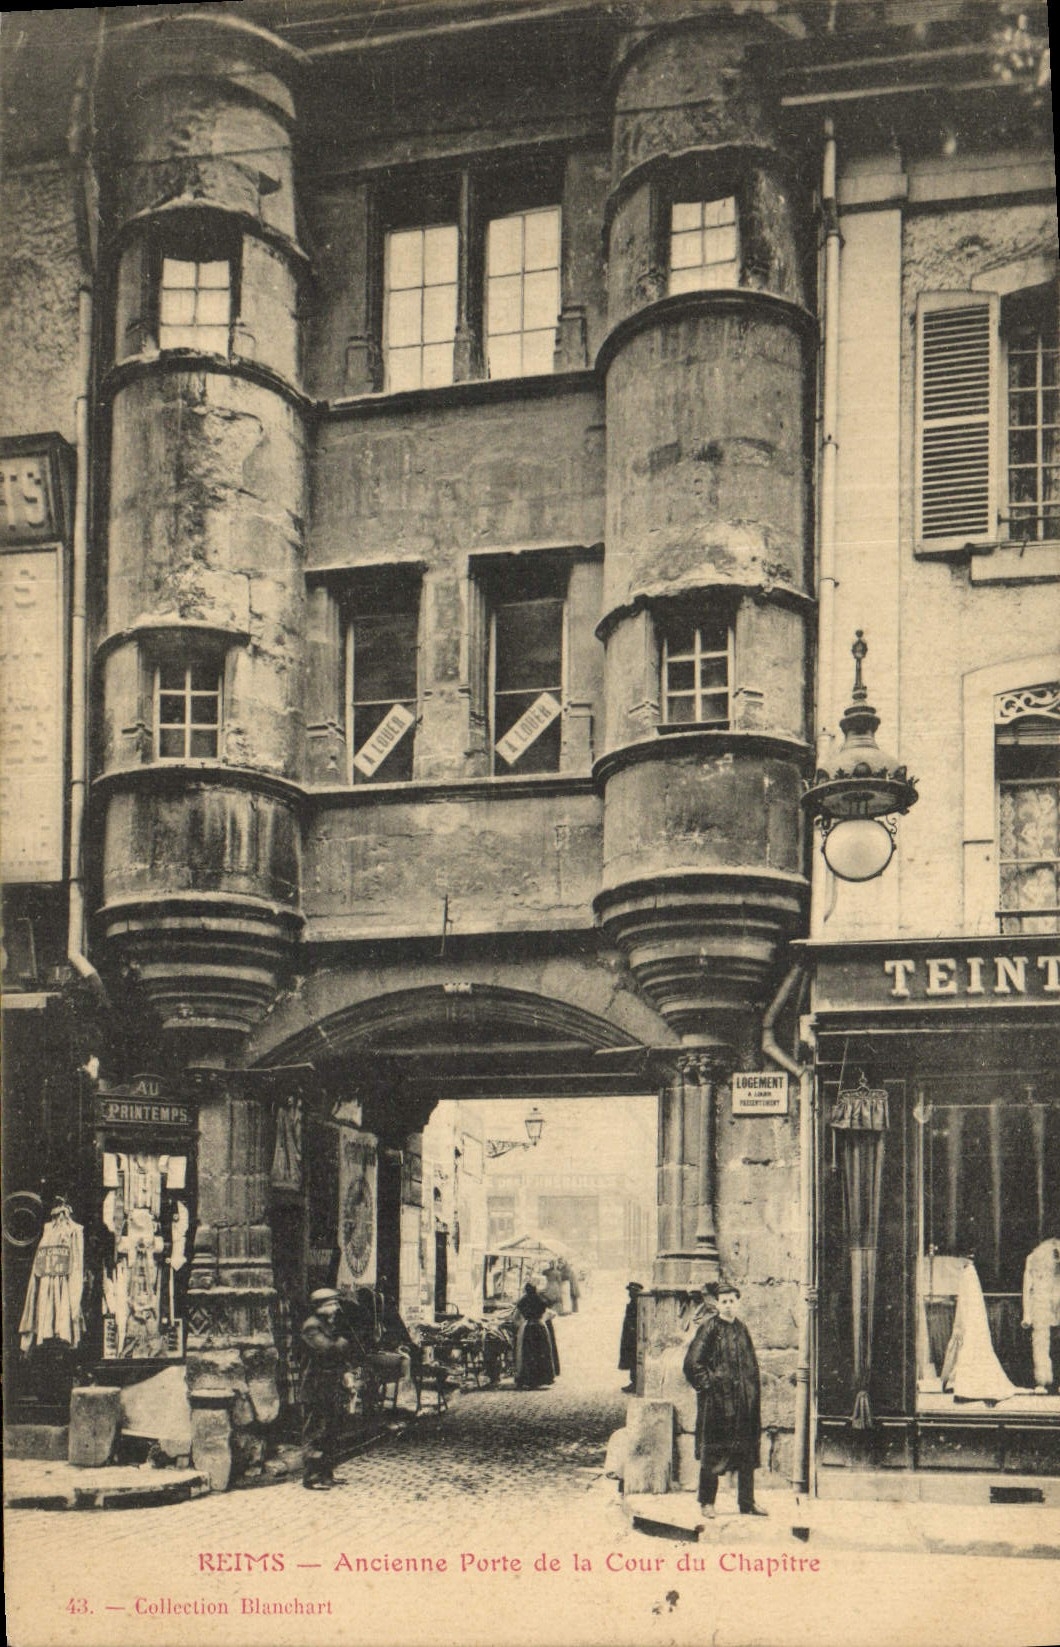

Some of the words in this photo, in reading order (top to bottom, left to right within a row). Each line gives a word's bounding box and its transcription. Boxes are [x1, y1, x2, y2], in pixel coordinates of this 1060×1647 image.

[361, 752, 376, 765] A
[370, 715, 407, 755] LOUER
[504, 739, 519, 753] A
[513, 705, 553, 742] LOUER
[884, 955, 1060, 998] TEINT
[138, 1080, 159, 1096] AU
[736, 1076, 784, 1089] LOGEMENT
[107, 1103, 188, 1122] PRINTEMPS
